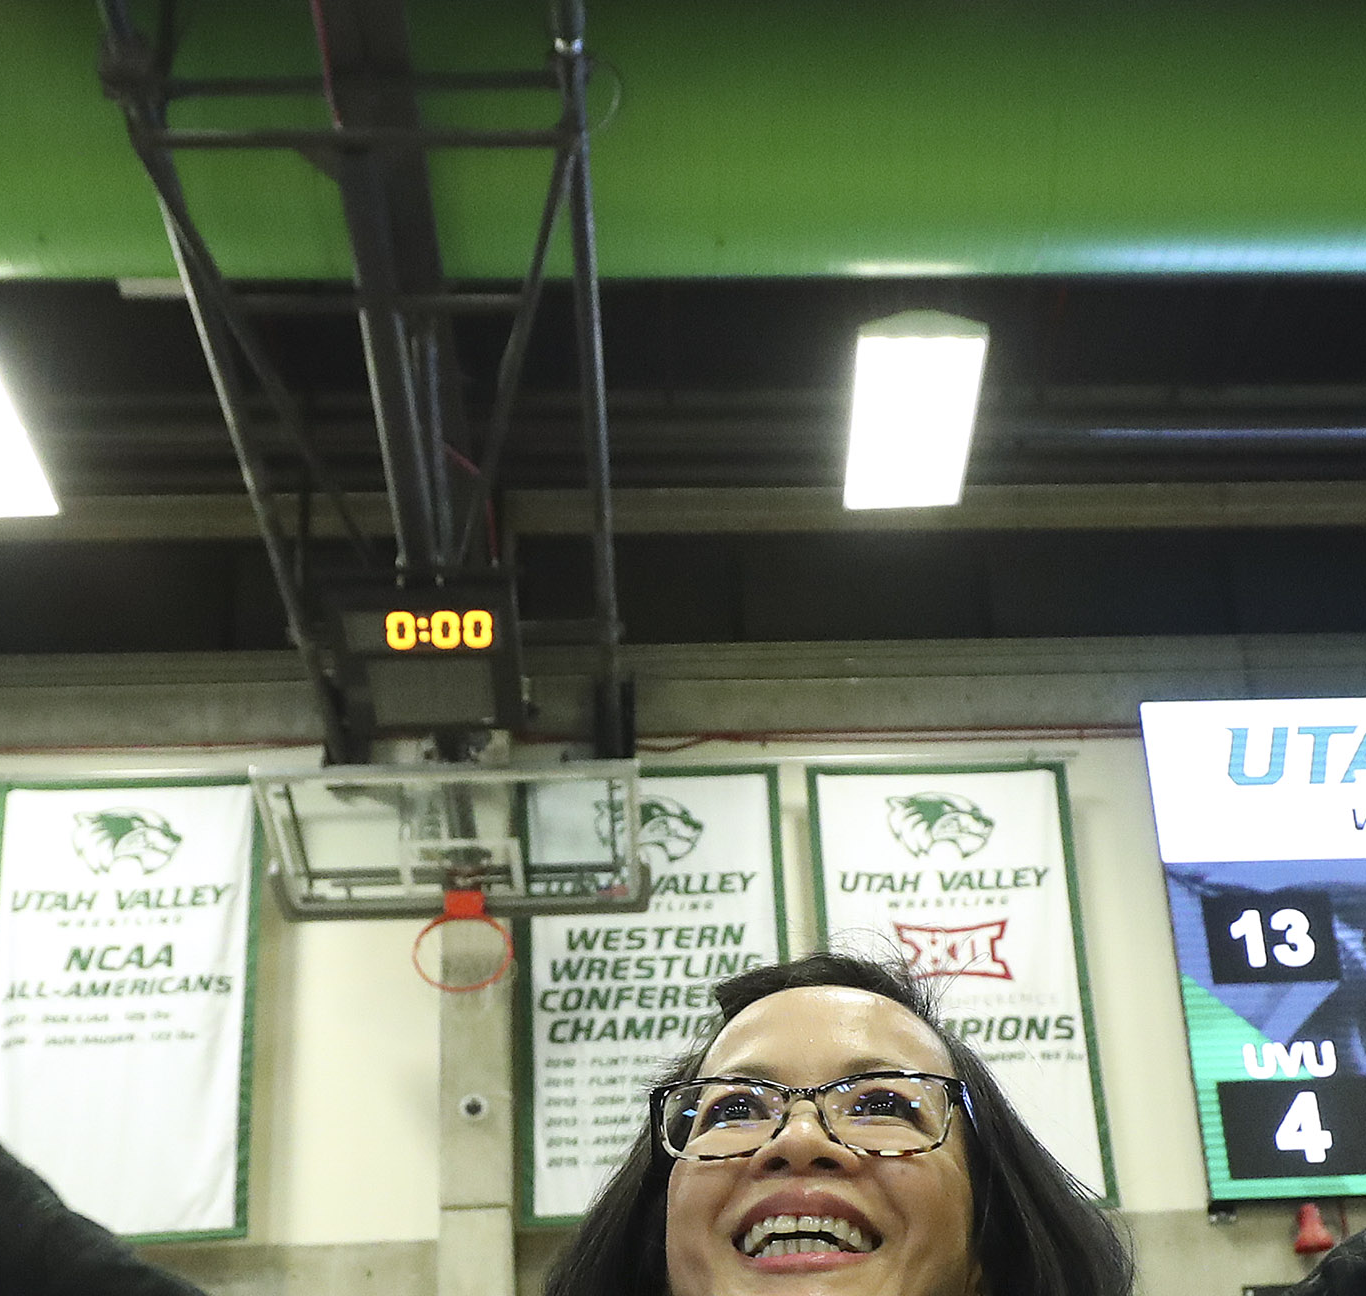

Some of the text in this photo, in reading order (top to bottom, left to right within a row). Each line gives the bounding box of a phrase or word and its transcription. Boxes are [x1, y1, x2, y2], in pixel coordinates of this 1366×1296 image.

[385, 609, 493, 651] 0:00
[840, 866, 1050, 893] UTAH VALLEY
[12, 883, 233, 912] UTAH VALLEY
[565, 922, 746, 951] WESTERN
[1230, 908, 1316, 969] 13
[63, 942, 174, 971] NCAA
[5, 974, 233, 1000] ALL-AMERICANS
[1242, 1040, 1336, 1079] UVU
[1274, 1091, 1332, 1164] 4
